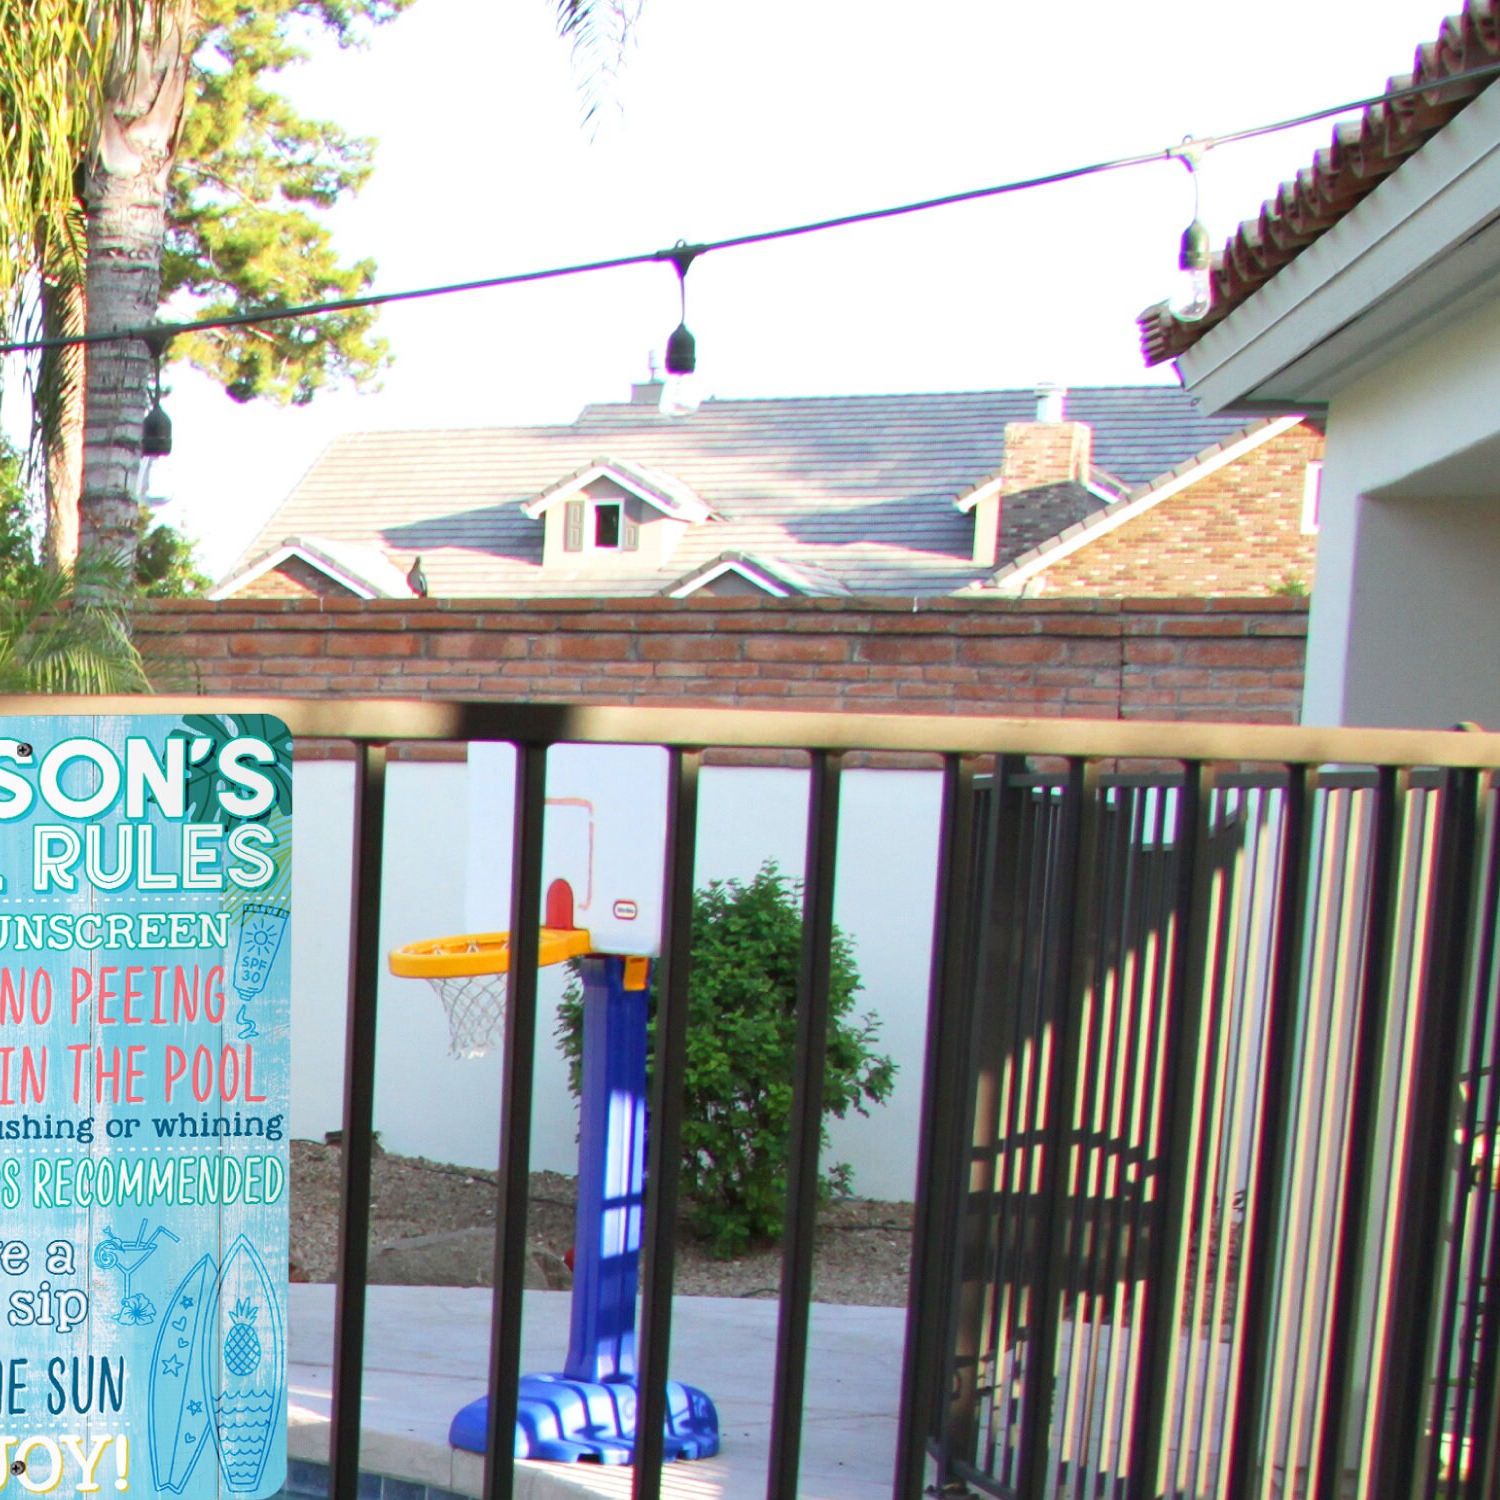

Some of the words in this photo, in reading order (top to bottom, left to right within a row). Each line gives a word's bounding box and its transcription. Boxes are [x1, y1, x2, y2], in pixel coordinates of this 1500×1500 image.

[33, 823, 277, 891] RULES
[241, 955, 268, 971] SPF
[241, 969, 261, 984] 30
[0, 966, 53, 1026] NO
[71, 965, 226, 1024] PEEING
[67, 1044, 146, 1103] THE
[165, 1043, 267, 1102] POOL
[106, 1117, 140, 1138] or
[152, 1113, 284, 1140] whining
[33, 1155, 285, 1208] RECOMMENDED
[45, 1240, 76, 1275] a
[7, 1281, 89, 1333] sip
[47, 1356, 125, 1415] SUN
